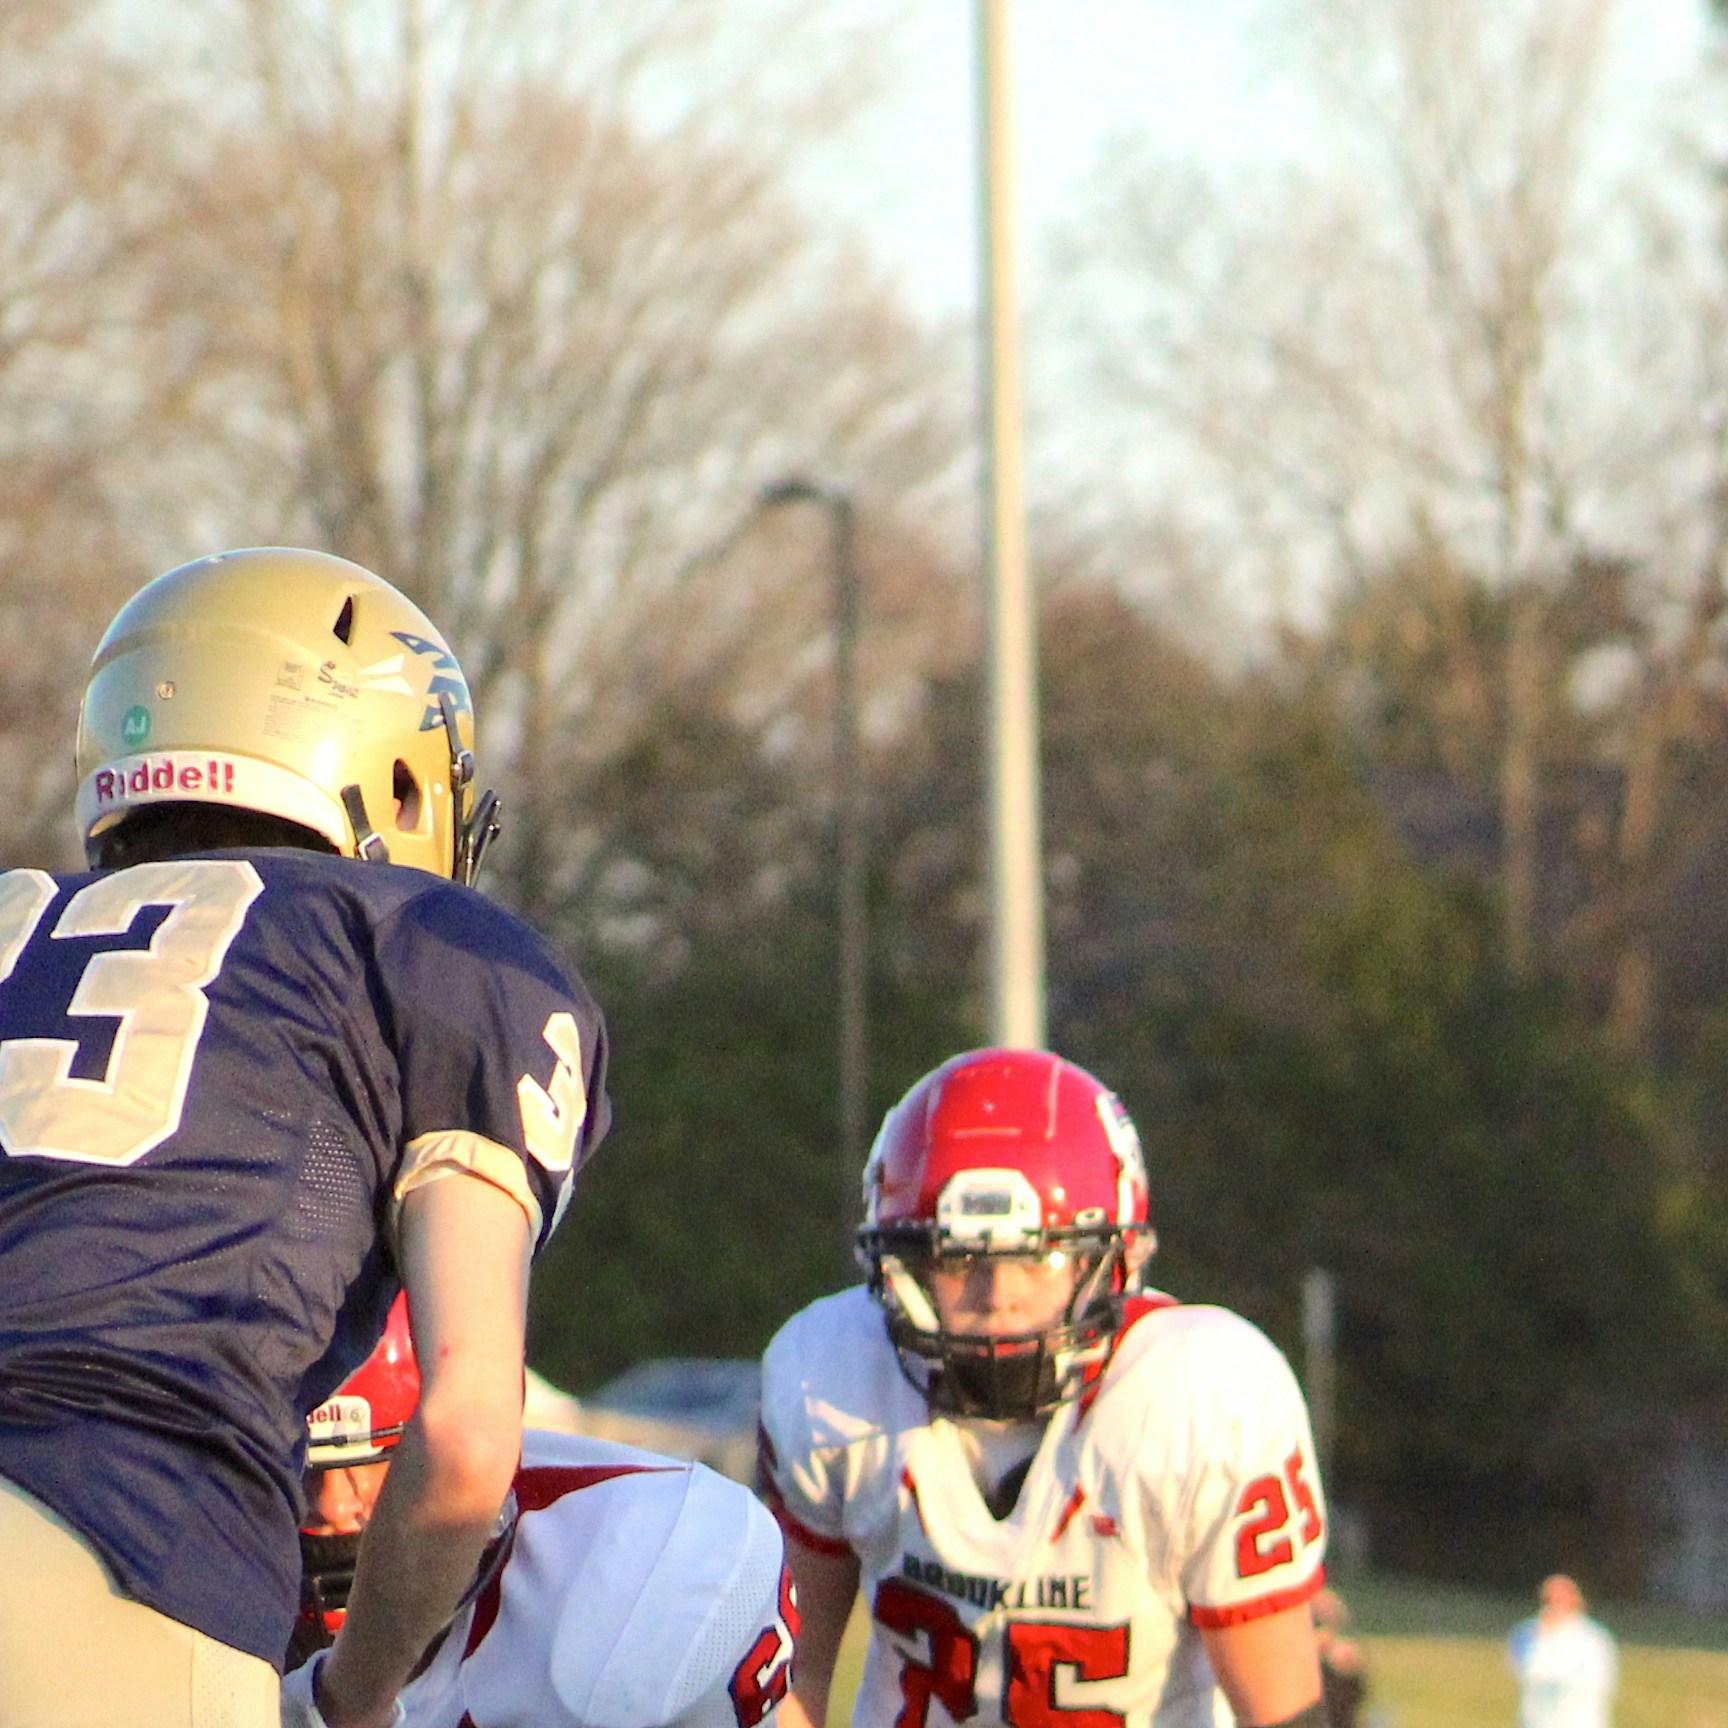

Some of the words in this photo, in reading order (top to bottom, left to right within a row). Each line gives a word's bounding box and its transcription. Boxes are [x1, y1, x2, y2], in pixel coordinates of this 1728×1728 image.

[124, 715, 148, 736] AJ
[95, 758, 235, 803] Riddell
[0, 859, 264, 1167] 3
[1233, 1448, 1324, 1580] 25
